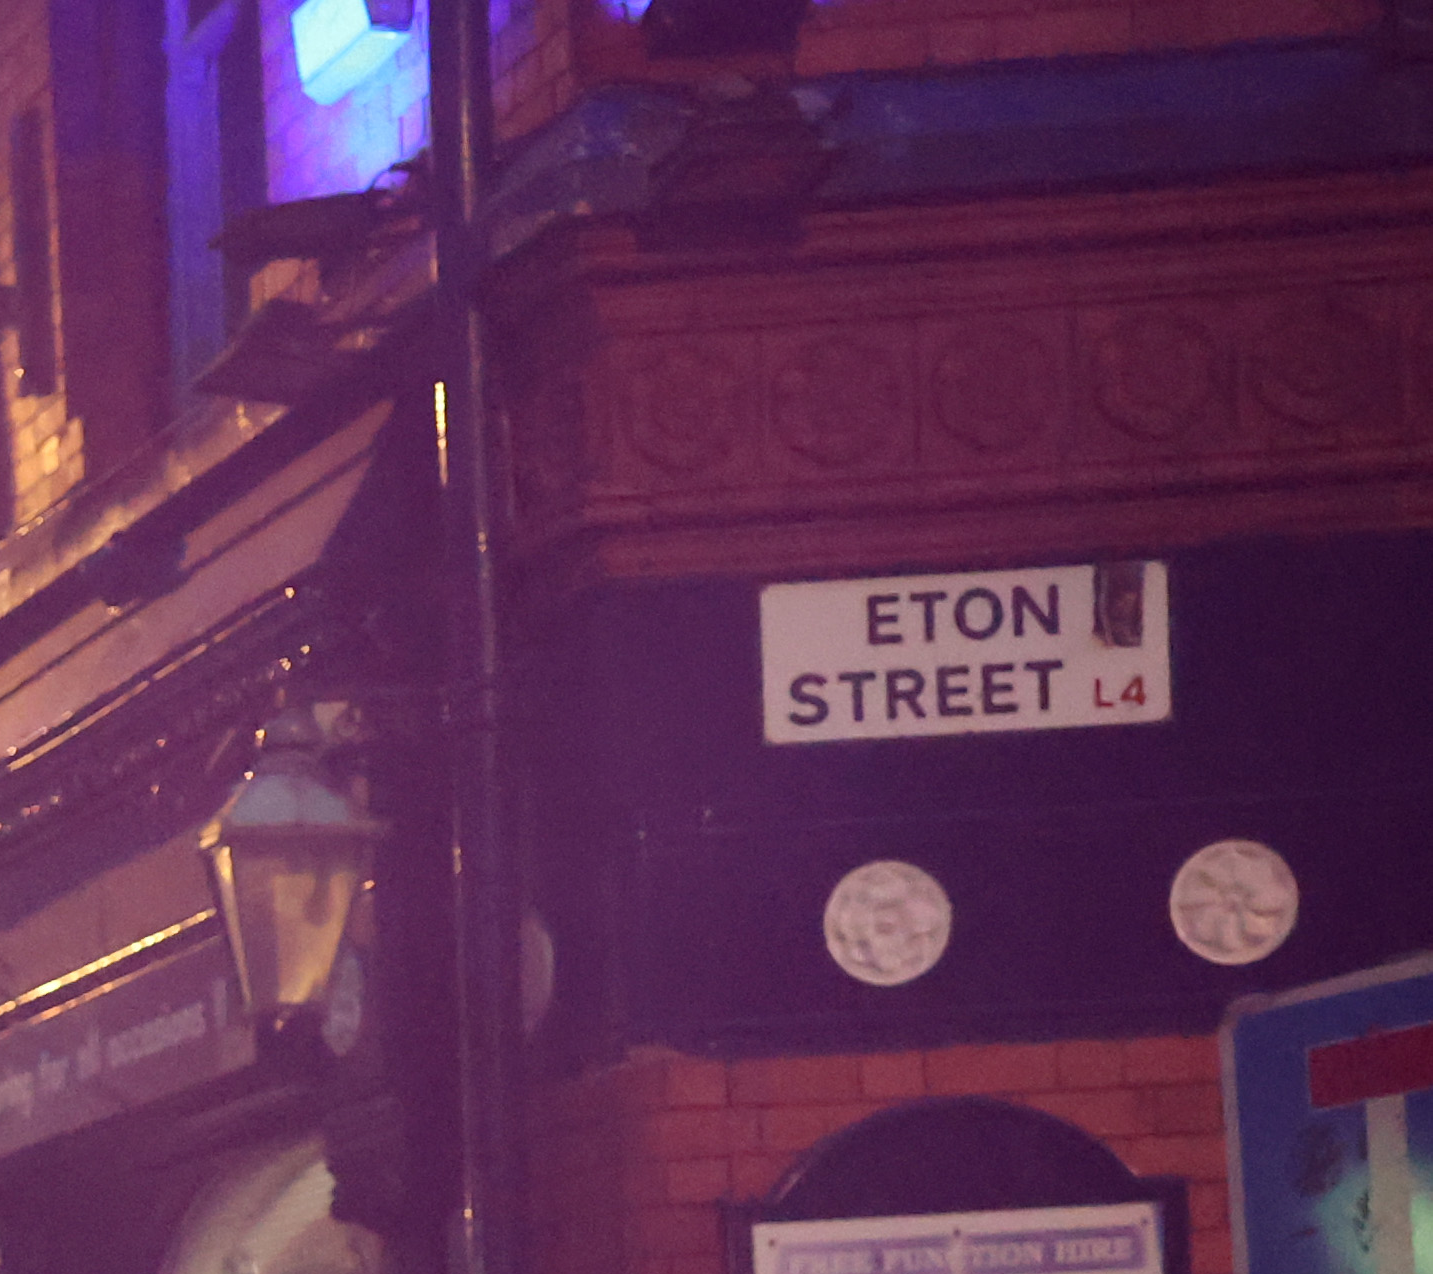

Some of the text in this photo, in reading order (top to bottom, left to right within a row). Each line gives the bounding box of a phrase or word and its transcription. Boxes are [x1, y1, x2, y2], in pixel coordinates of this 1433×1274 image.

[865, 582, 1061, 646] ETON
[788, 659, 1147, 727] STREET L4
[1055, 1235, 1134, 1266] HIRE
